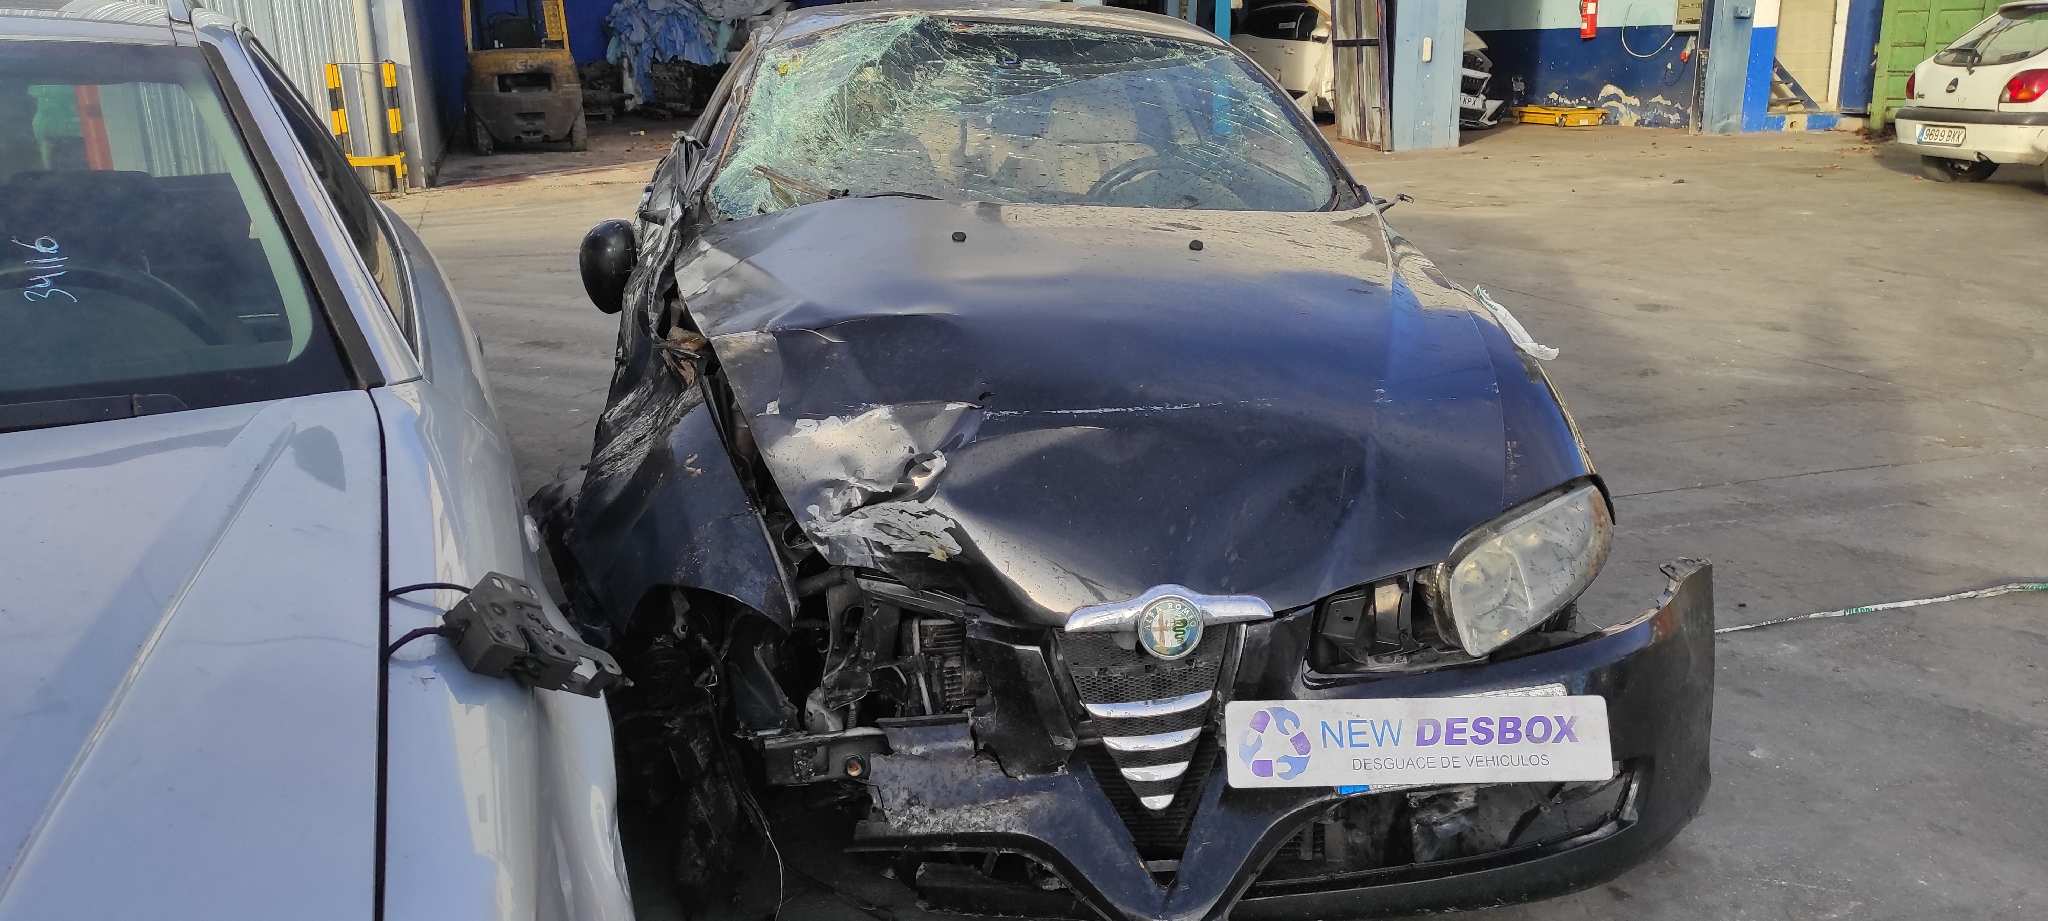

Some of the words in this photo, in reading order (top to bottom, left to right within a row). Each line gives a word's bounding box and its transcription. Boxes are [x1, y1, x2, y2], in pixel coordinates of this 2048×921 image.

[11, 236, 78, 303] 34116
[1144, 606, 1162, 631] ALFA
[1167, 602, 1197, 628] ROMEO
[1321, 718, 1403, 749] NEW
[1416, 715, 1580, 747] DESBOX
[1352, 756, 1436, 771] DESGUACE
[1440, 755, 1462, 769] DE
[1464, 753, 1550, 768] VEHICULOS
